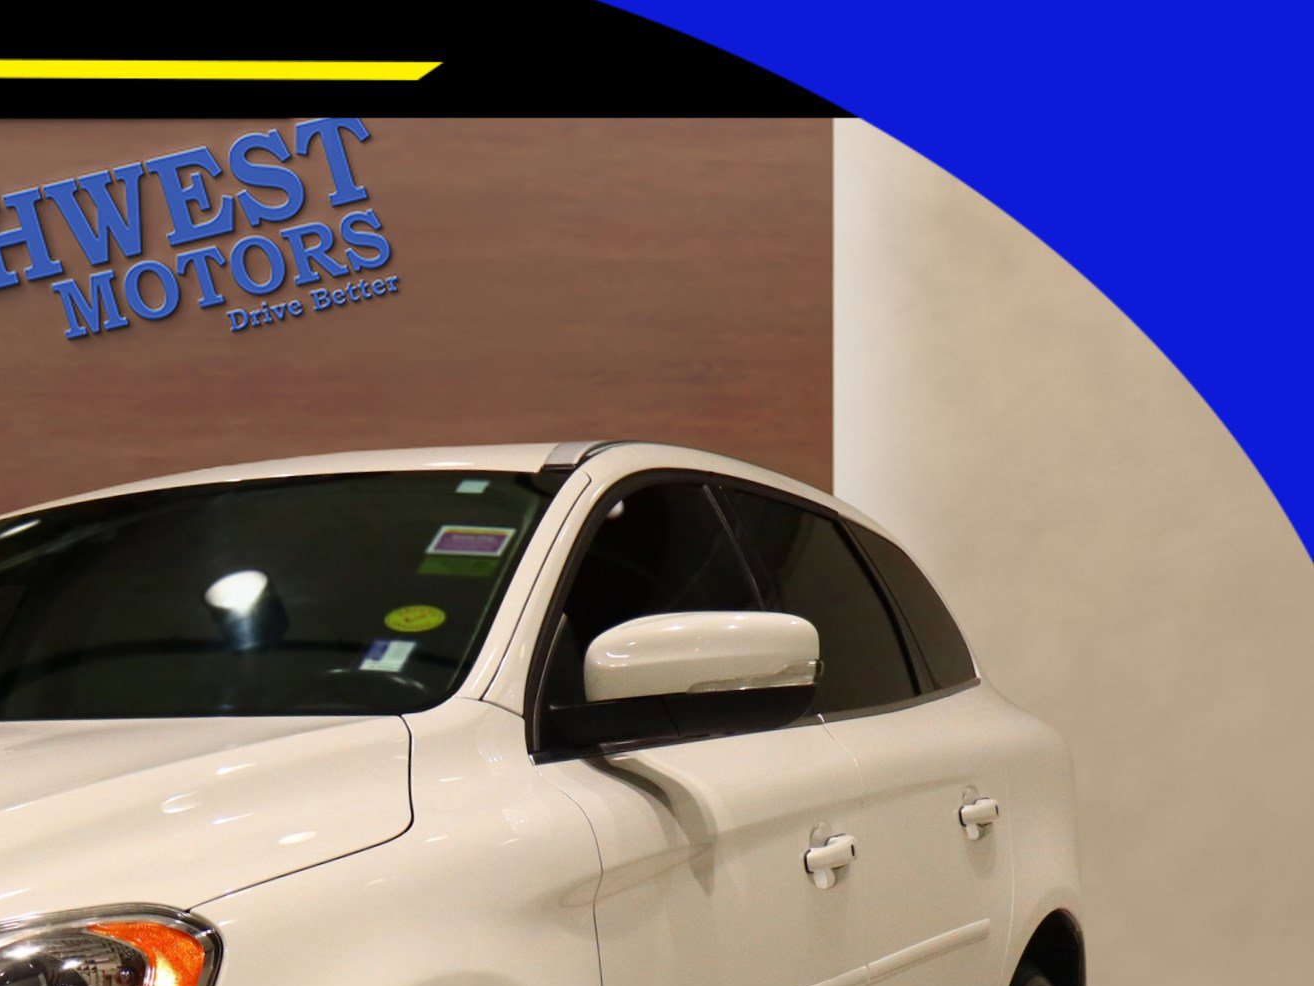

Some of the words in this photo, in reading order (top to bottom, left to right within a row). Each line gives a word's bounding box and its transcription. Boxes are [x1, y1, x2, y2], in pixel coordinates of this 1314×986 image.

[51, 208, 392, 340] MOTORS
[226, 294, 303, 333] Drive
[309, 272, 401, 312] Better
